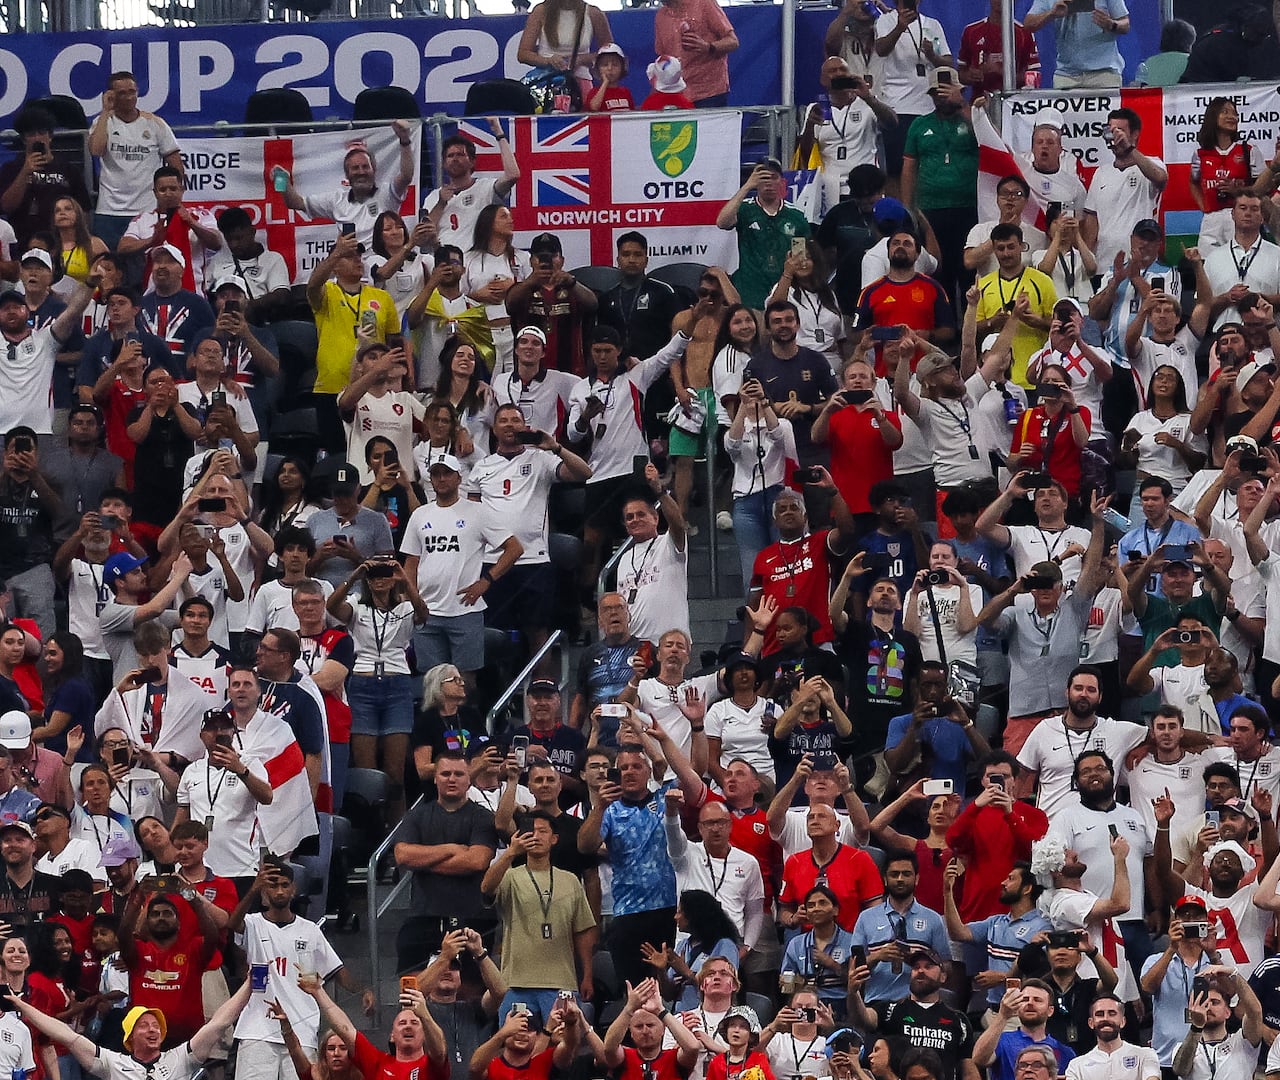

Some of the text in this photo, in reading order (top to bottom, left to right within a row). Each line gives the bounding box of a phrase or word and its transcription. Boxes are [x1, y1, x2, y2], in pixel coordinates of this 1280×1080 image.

[48, 41, 235, 118] CUP
[255, 29, 521, 110] 202
[1011, 97, 1112, 117] ASHOVER
[1194, 96, 1250, 109] TUEL
[1061, 121, 1103, 138] AMS
[1238, 129, 1272, 142] GAIN
[643, 180, 705, 200] OTBC
[537, 208, 665, 226] NORWICH CITY
[648, 245, 693, 258] ILLIAM
[502, 479, 512, 496] 9
[425, 534, 461, 553] USA
[888, 558, 904, 578] 10
[275, 956, 288, 977] 11
[903, 1024, 954, 1043] Emirates
